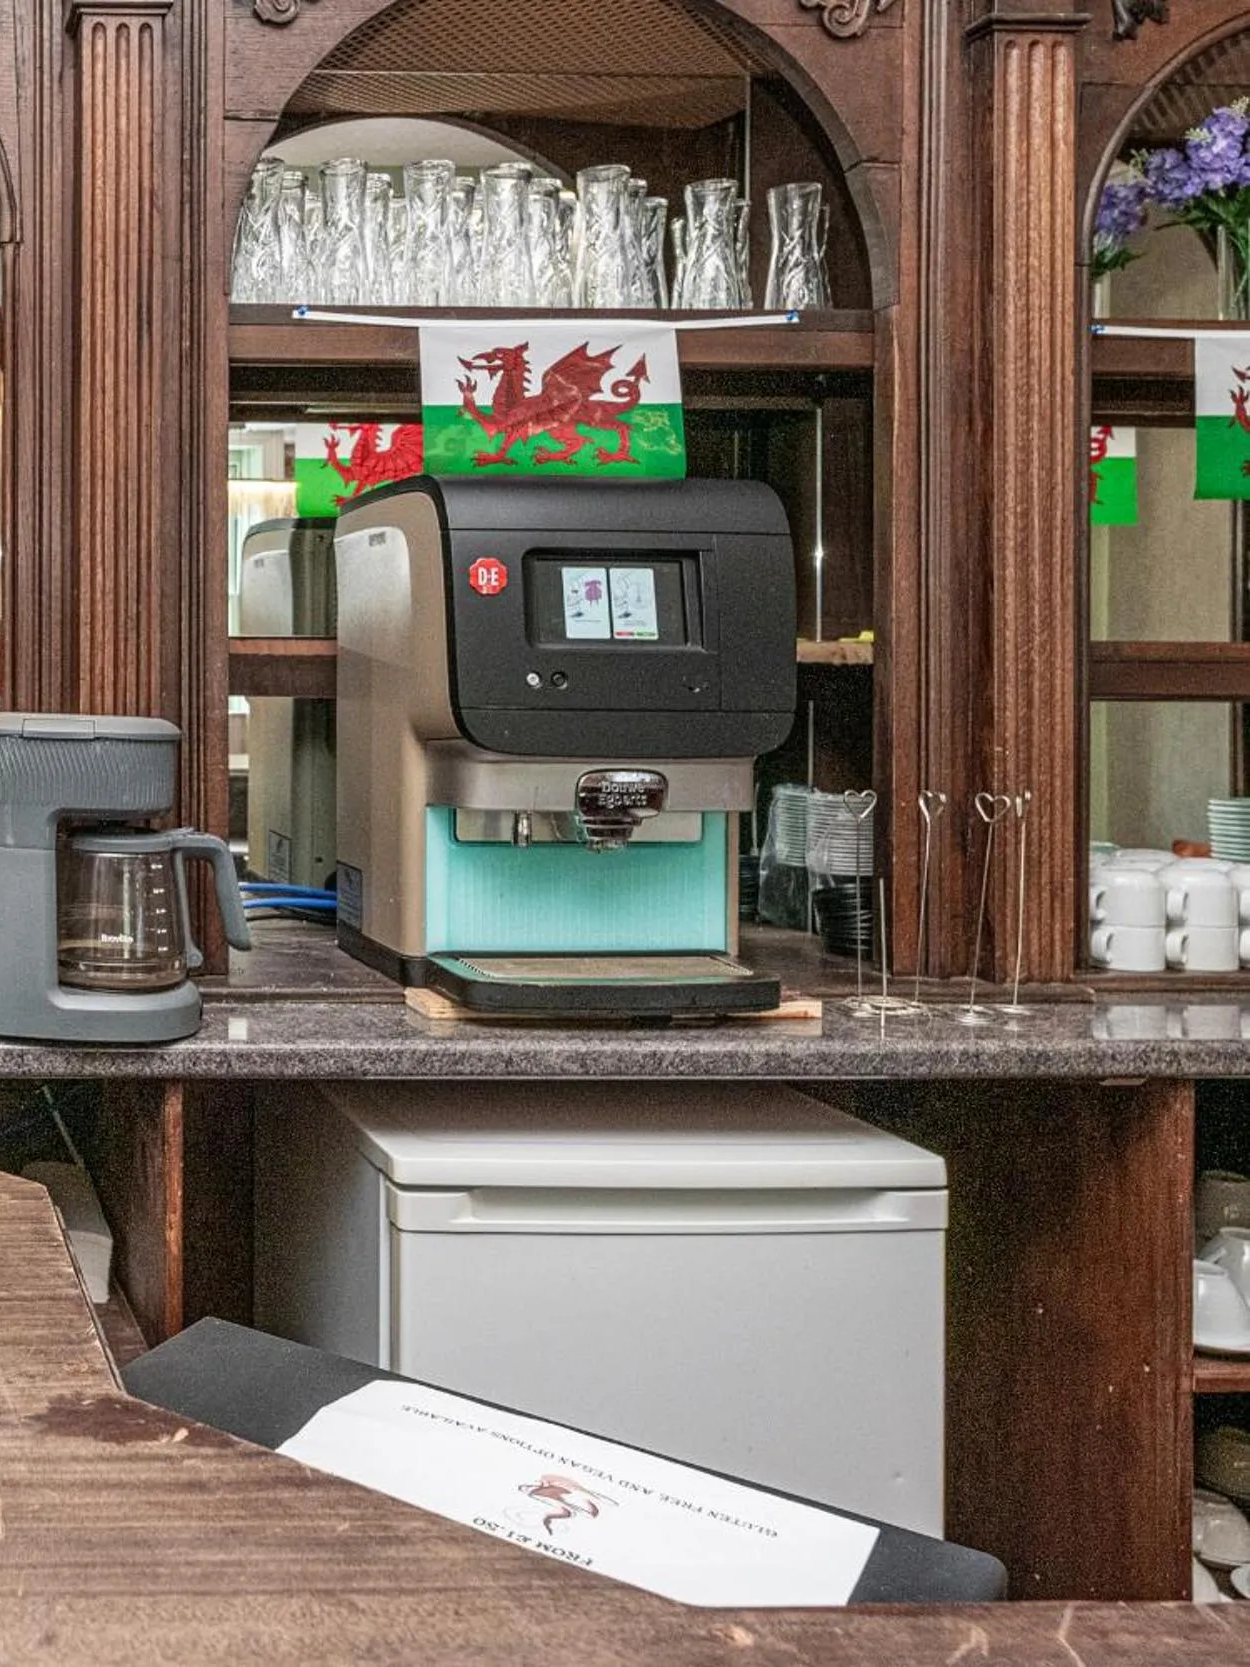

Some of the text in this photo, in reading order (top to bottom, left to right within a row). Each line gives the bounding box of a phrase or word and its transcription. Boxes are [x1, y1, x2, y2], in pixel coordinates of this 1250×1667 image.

[402, 1404, 778, 1538] GLUTEN FREE AND VEGAN OPTIONS AVAILABLE
[535, 1541, 593, 1566] FROM
